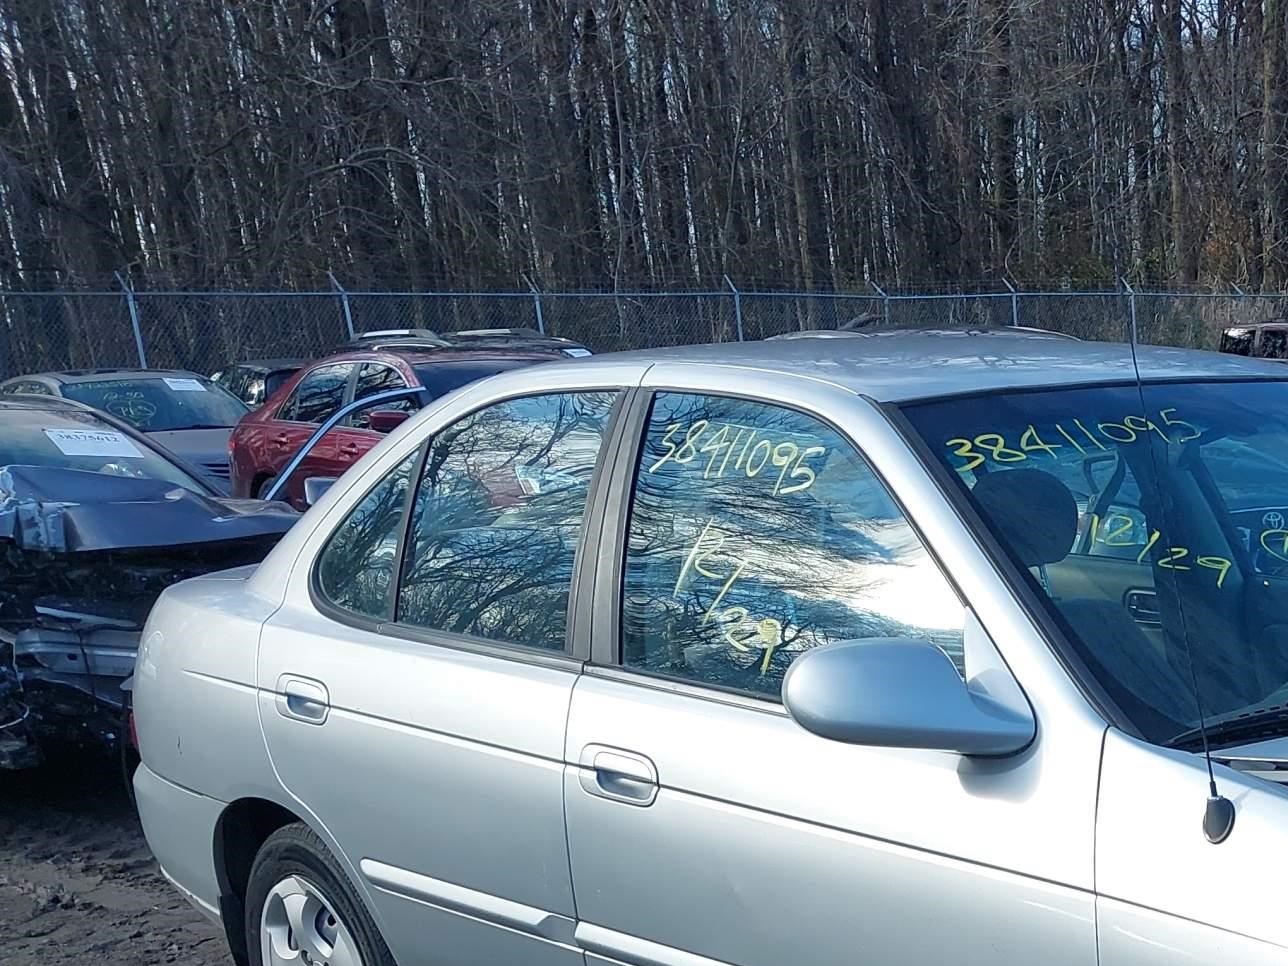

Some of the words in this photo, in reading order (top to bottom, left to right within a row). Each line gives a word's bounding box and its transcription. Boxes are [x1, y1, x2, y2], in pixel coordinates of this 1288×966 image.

[649, 420, 825, 496] 38411095
[946, 409, 1201, 472] 38411095
[1091, 514, 1232, 588] 12/29
